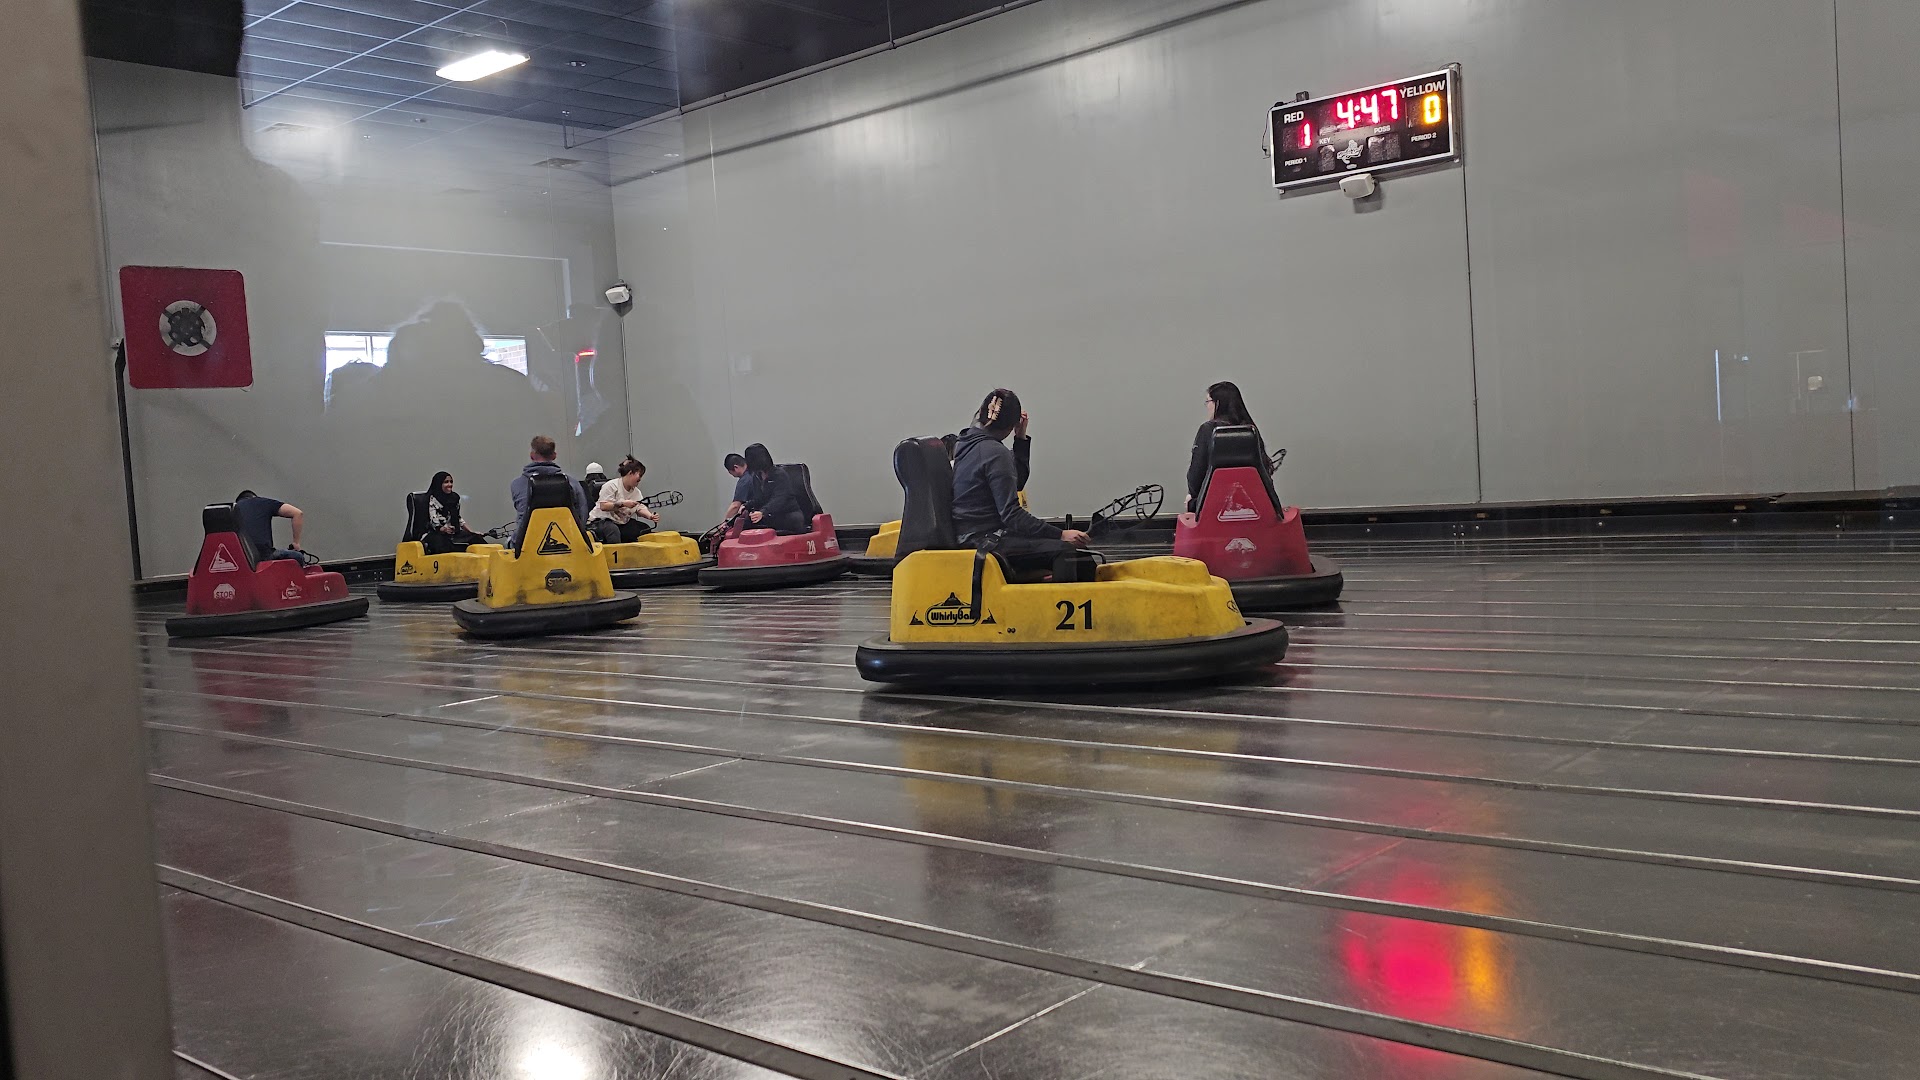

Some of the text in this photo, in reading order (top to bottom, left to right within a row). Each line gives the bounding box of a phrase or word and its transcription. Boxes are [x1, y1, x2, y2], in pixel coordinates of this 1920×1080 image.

[1399, 80, 1446, 99] YELLOW
[1336, 88, 1398, 129] 4:47
[1424, 94, 1441, 124] 0
[1283, 111, 1305, 124] RED
[1303, 122, 1311, 147] 1
[1373, 125, 1391, 134] POSS
[1319, 137, 1331, 145] KEY
[1410, 133, 1431, 143] PERIOD
[1284, 158, 1303, 167] PERIOD
[612, 550, 618, 564] 1
[433, 560, 439, 574] 9
[215, 590, 234, 599] STOP
[930, 609, 977, 621] WhirlyBal
[1055, 599, 1093, 631] 21
